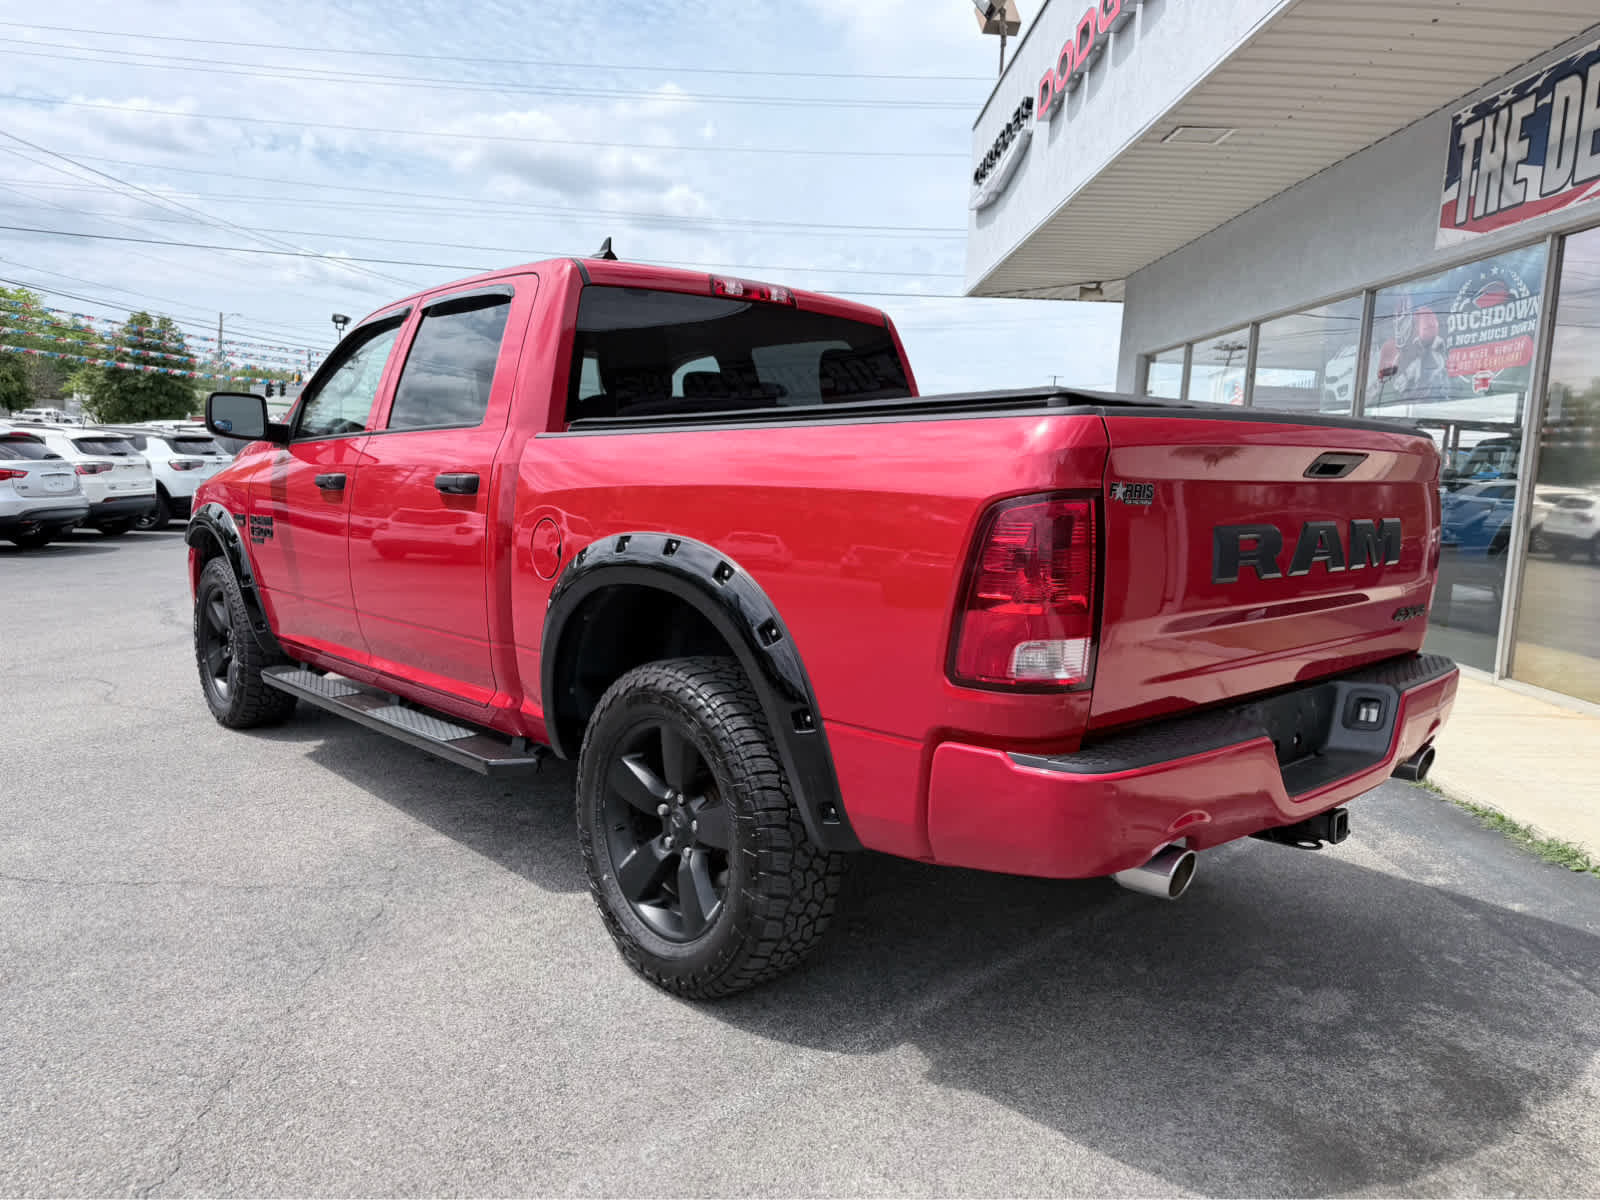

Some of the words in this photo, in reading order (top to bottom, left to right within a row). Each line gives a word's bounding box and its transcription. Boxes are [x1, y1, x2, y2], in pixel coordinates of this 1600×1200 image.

[1455, 92, 1537, 226] THE
[1447, 296, 1543, 334] OUCHDOWN
[1480, 326, 1509, 343] MUCH
[1212, 517, 1402, 584] RAM
